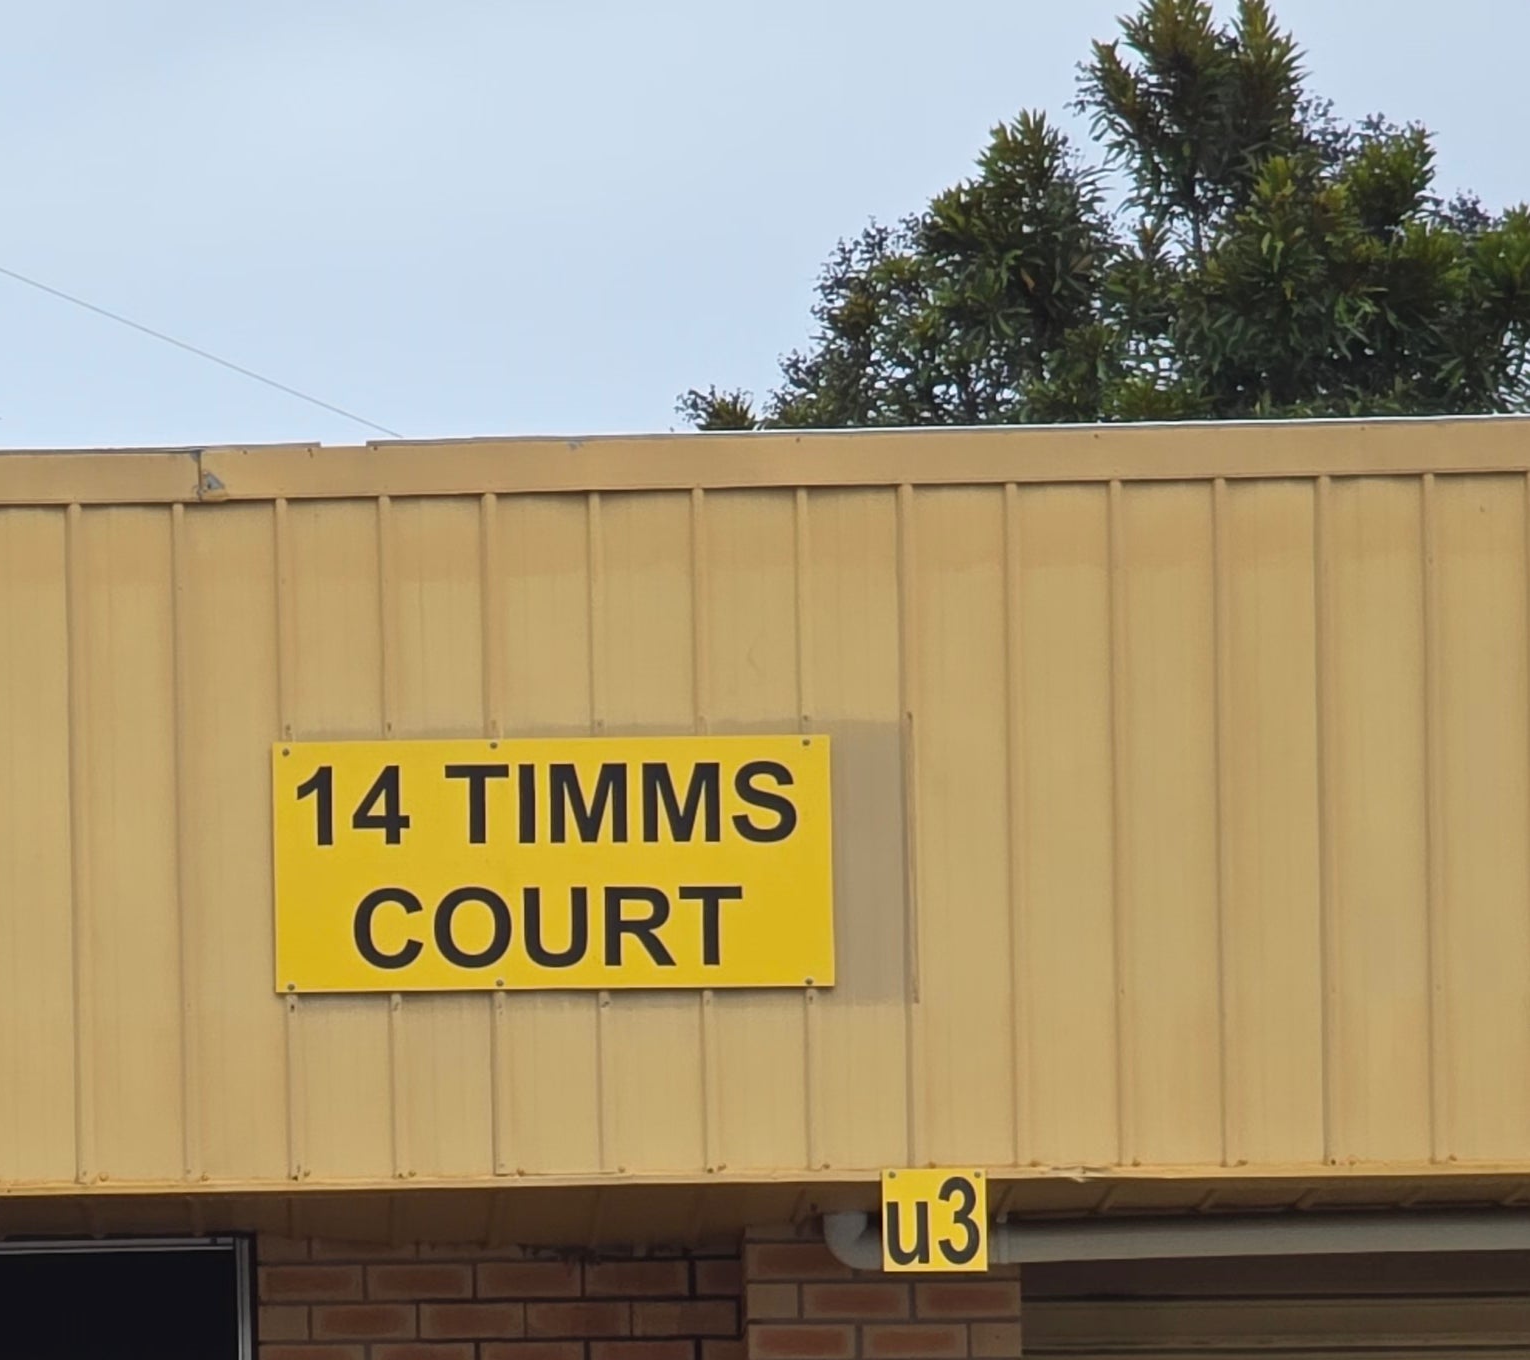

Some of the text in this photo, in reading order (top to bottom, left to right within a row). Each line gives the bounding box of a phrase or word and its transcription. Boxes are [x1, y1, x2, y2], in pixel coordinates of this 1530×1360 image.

[296, 760, 798, 846] 14 TIMMS
[353, 886, 743, 970] COURT
[886, 1177, 981, 1266] u3
